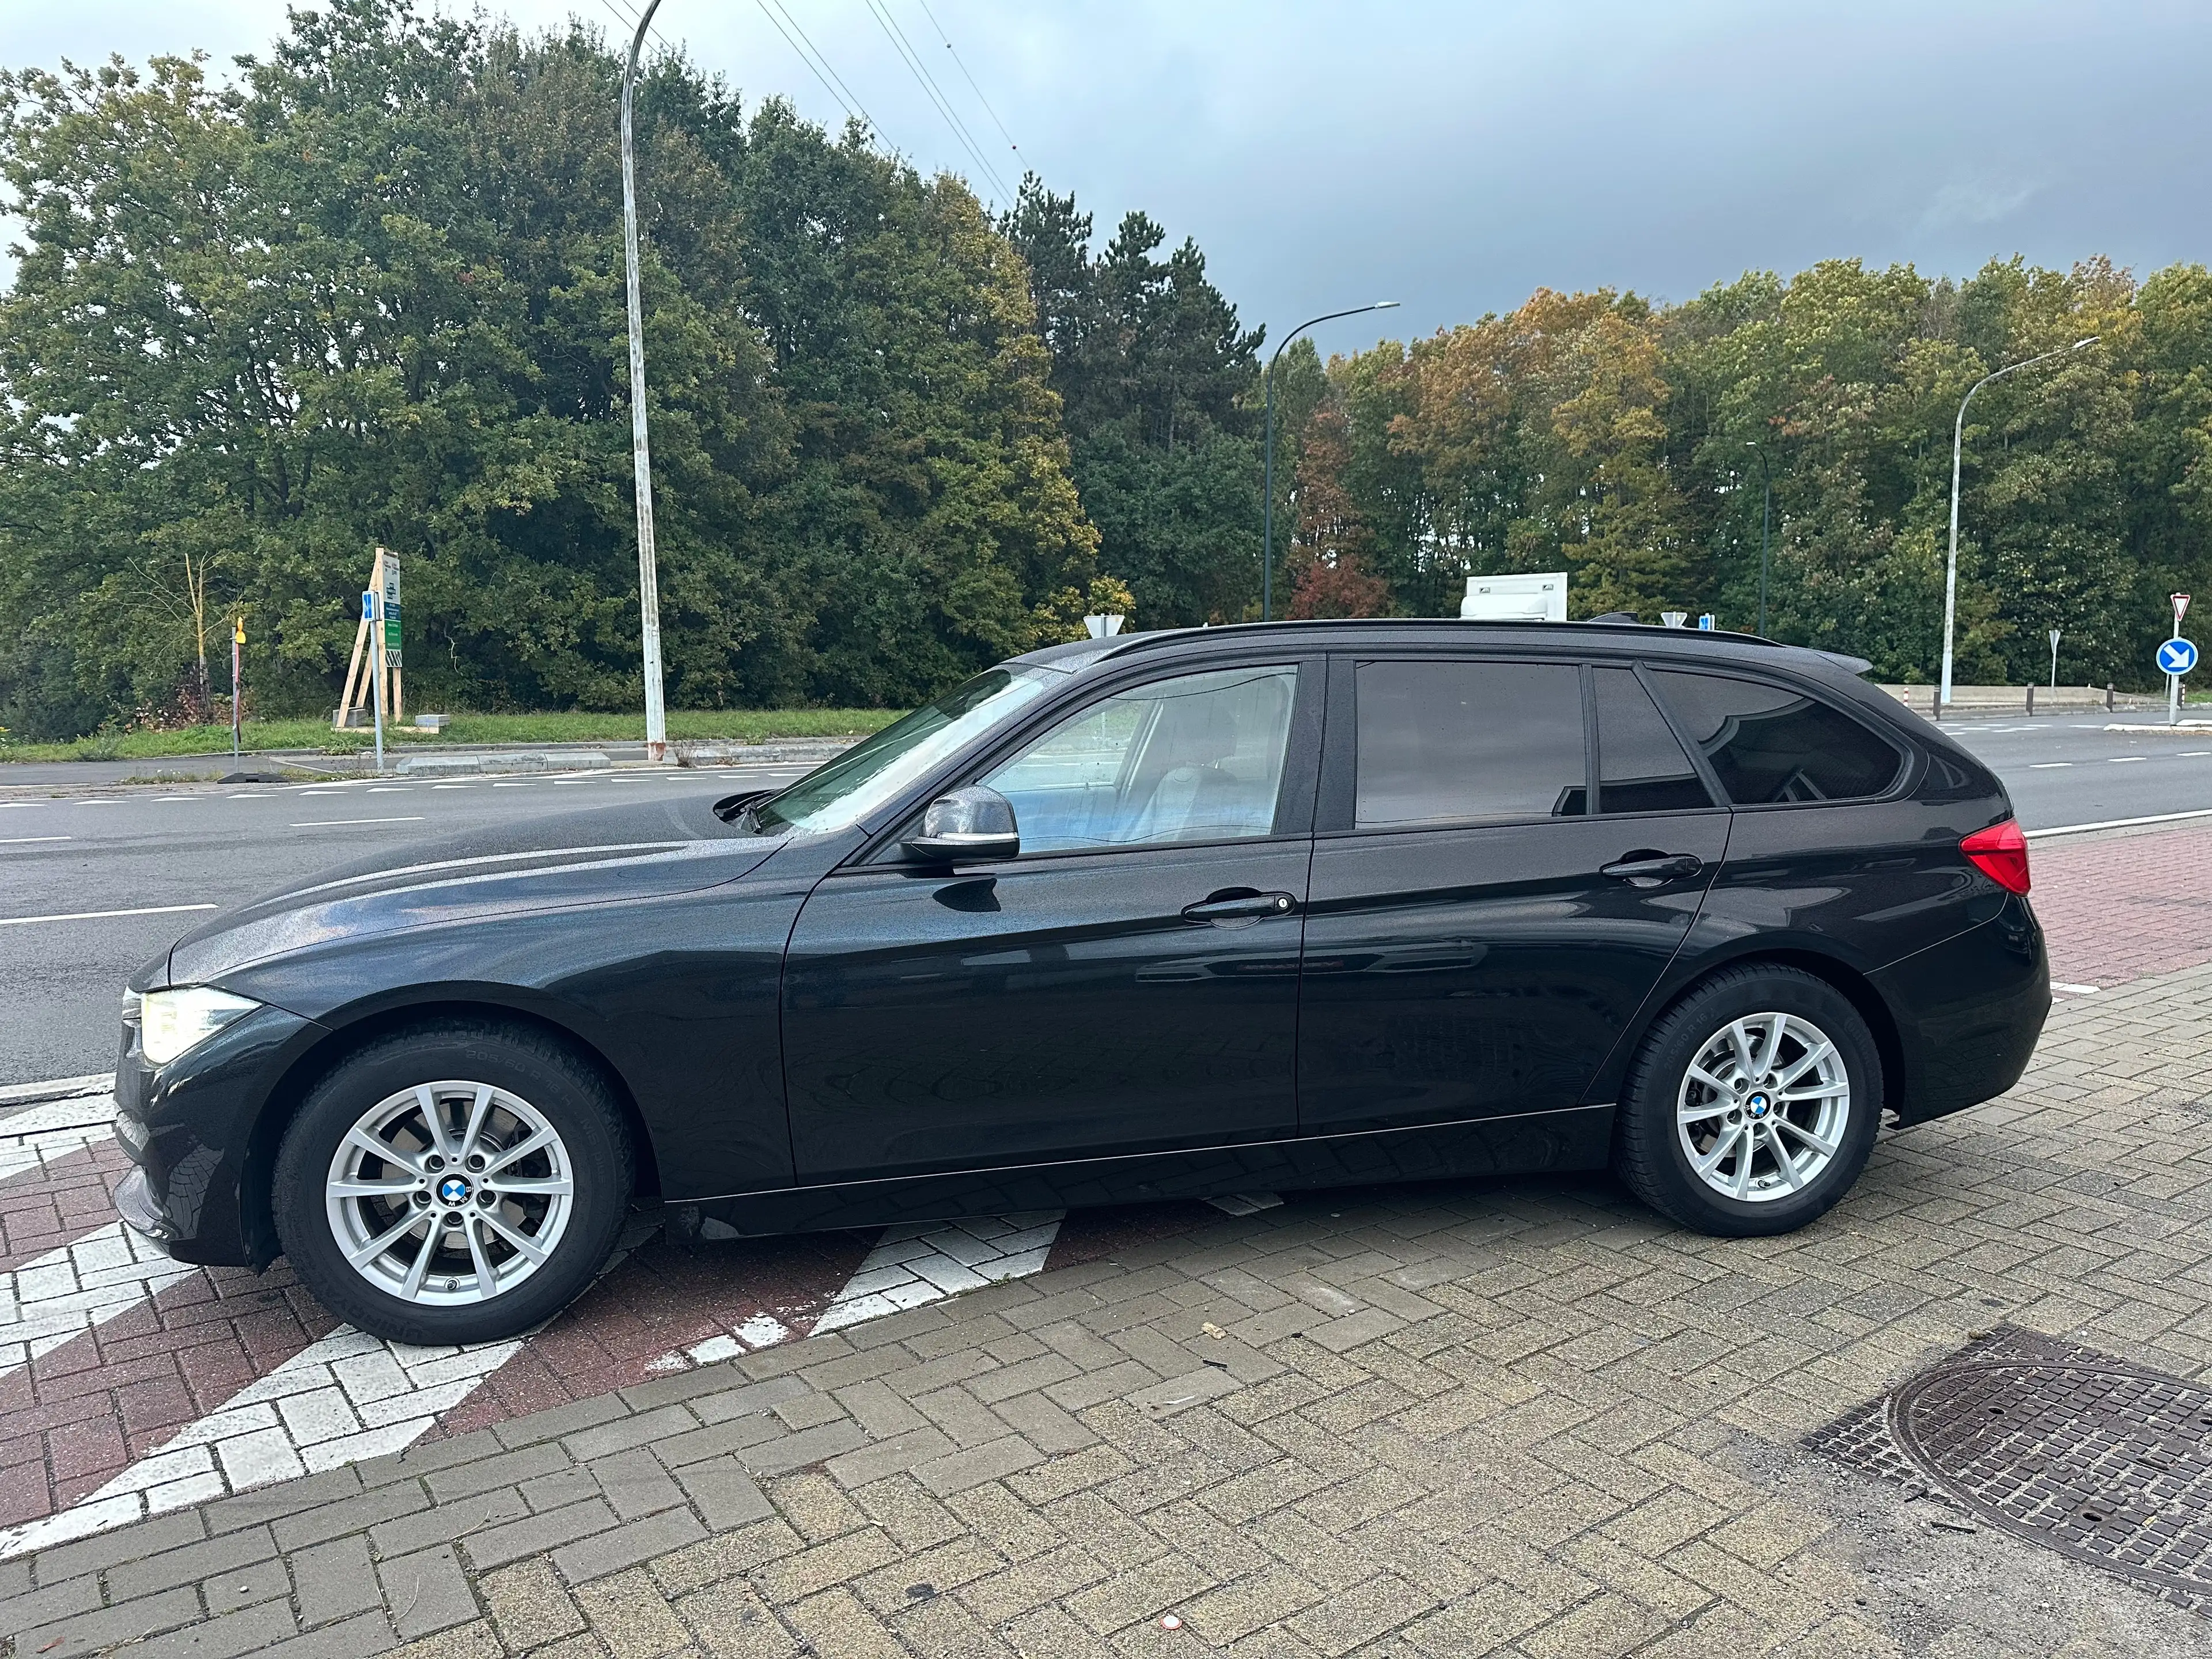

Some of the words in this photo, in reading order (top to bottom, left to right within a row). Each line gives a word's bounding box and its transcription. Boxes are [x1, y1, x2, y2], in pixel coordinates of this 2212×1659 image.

[1696, 1013, 1708, 1025] 16
[465, 1048, 526, 1073] 205/60
[529, 1069, 542, 1084] R
[546, 1080, 560, 1093] 16
[448, 1186, 472, 1207] BMW
